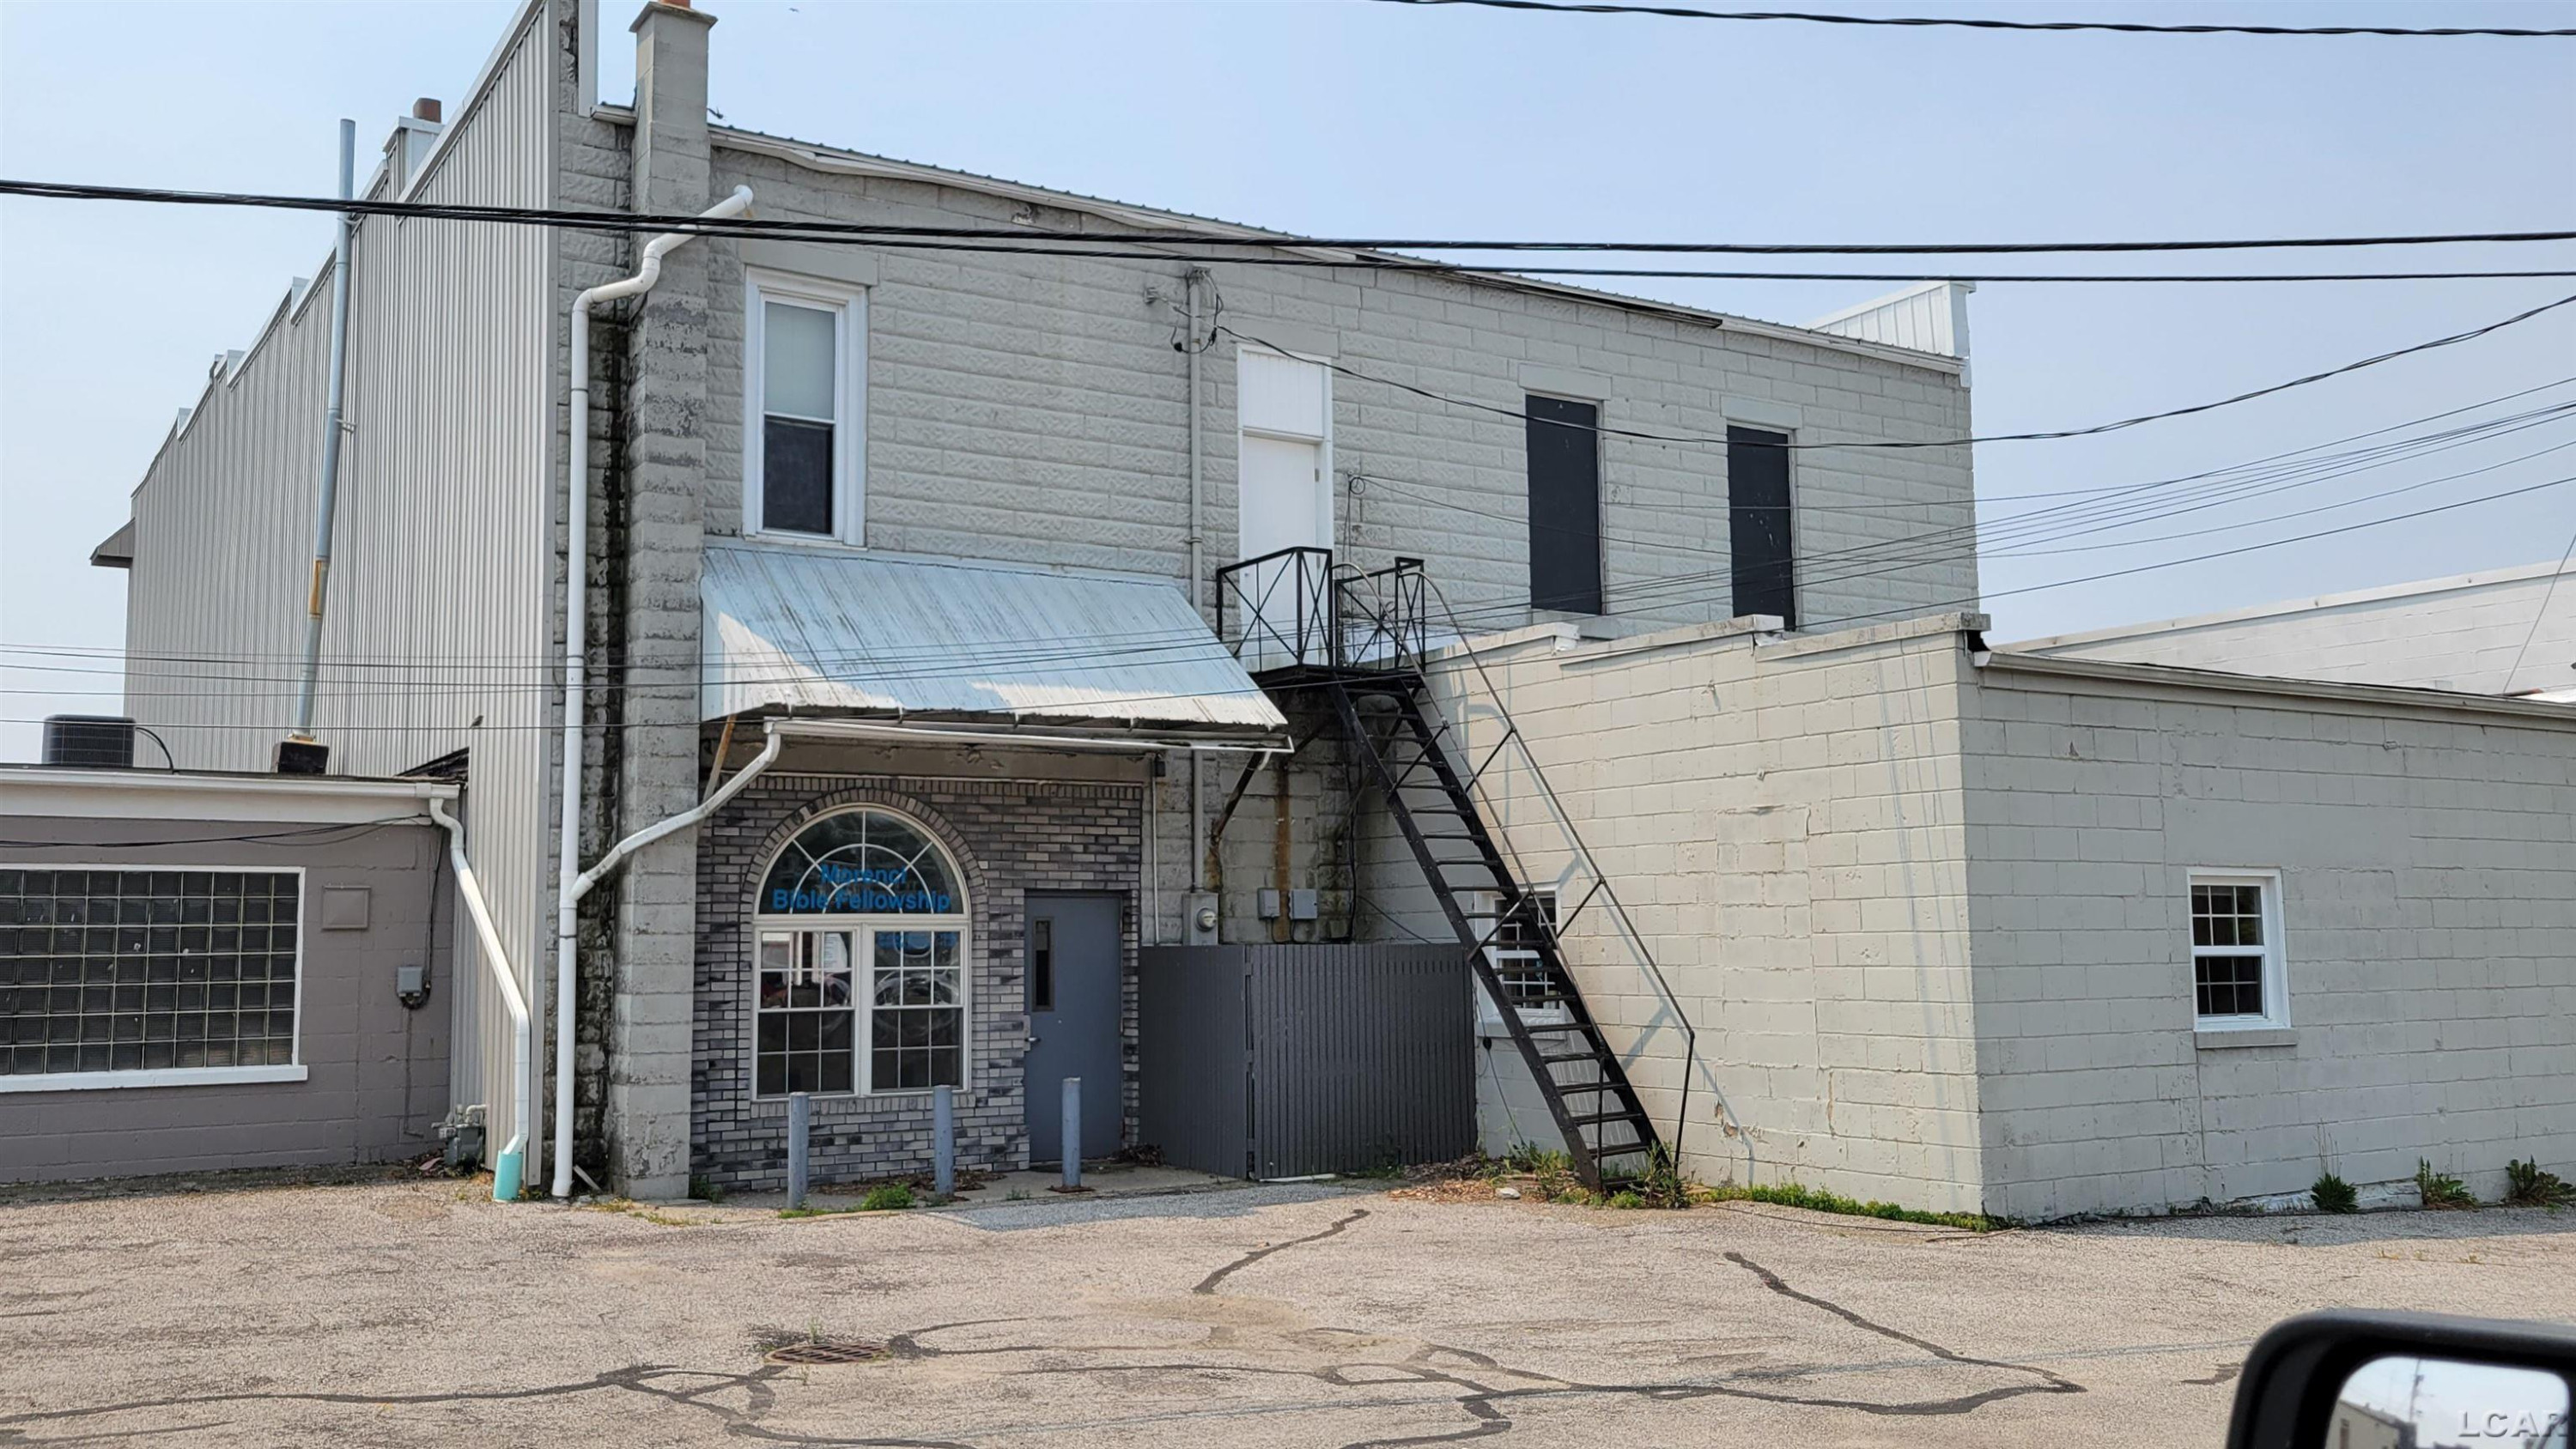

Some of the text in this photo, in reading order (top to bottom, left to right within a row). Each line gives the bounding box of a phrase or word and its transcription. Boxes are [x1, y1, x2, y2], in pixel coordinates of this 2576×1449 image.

[821, 864, 908, 883] Morenci
[773, 888, 951, 912] Bible Fellowship
